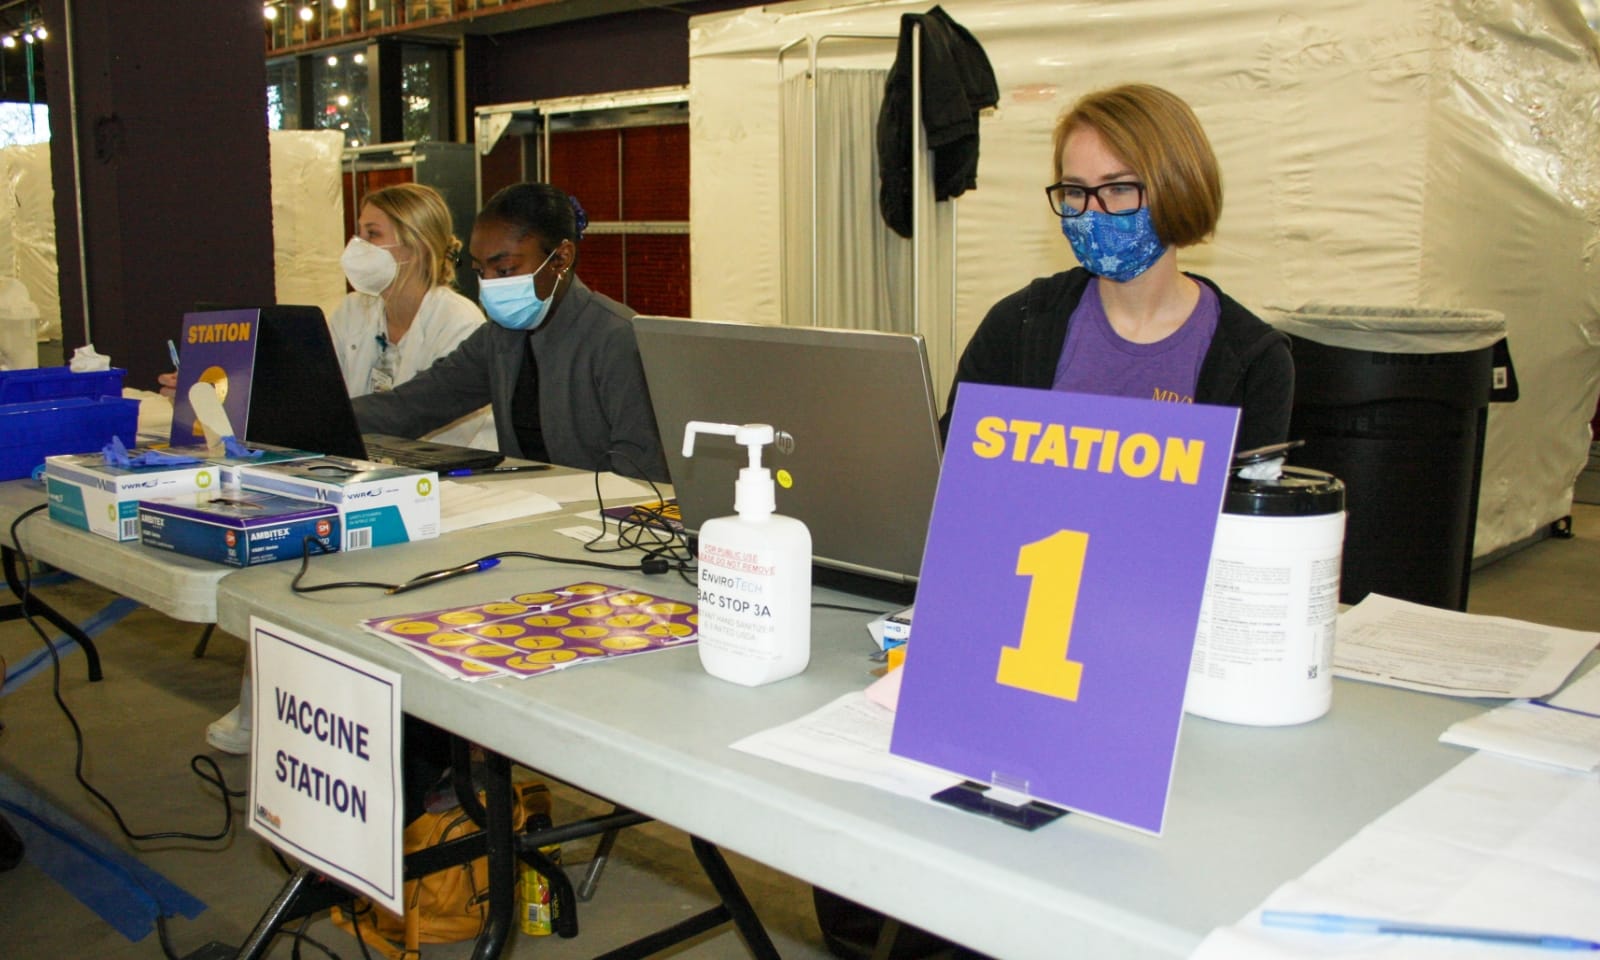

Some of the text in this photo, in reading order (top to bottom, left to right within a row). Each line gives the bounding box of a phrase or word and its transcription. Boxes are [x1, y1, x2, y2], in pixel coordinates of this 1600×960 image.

[188, 322, 252, 345] STATION
[971, 415, 1205, 485] STATION
[250, 528, 290, 541] AMBITEX
[742, 563, 776, 576] REMOVE
[719, 596, 750, 613] STOP
[754, 604, 772, 618] 3A
[995, 529, 1090, 702] 1
[275, 686, 370, 761] VACCINE
[275, 749, 367, 824] STATION
